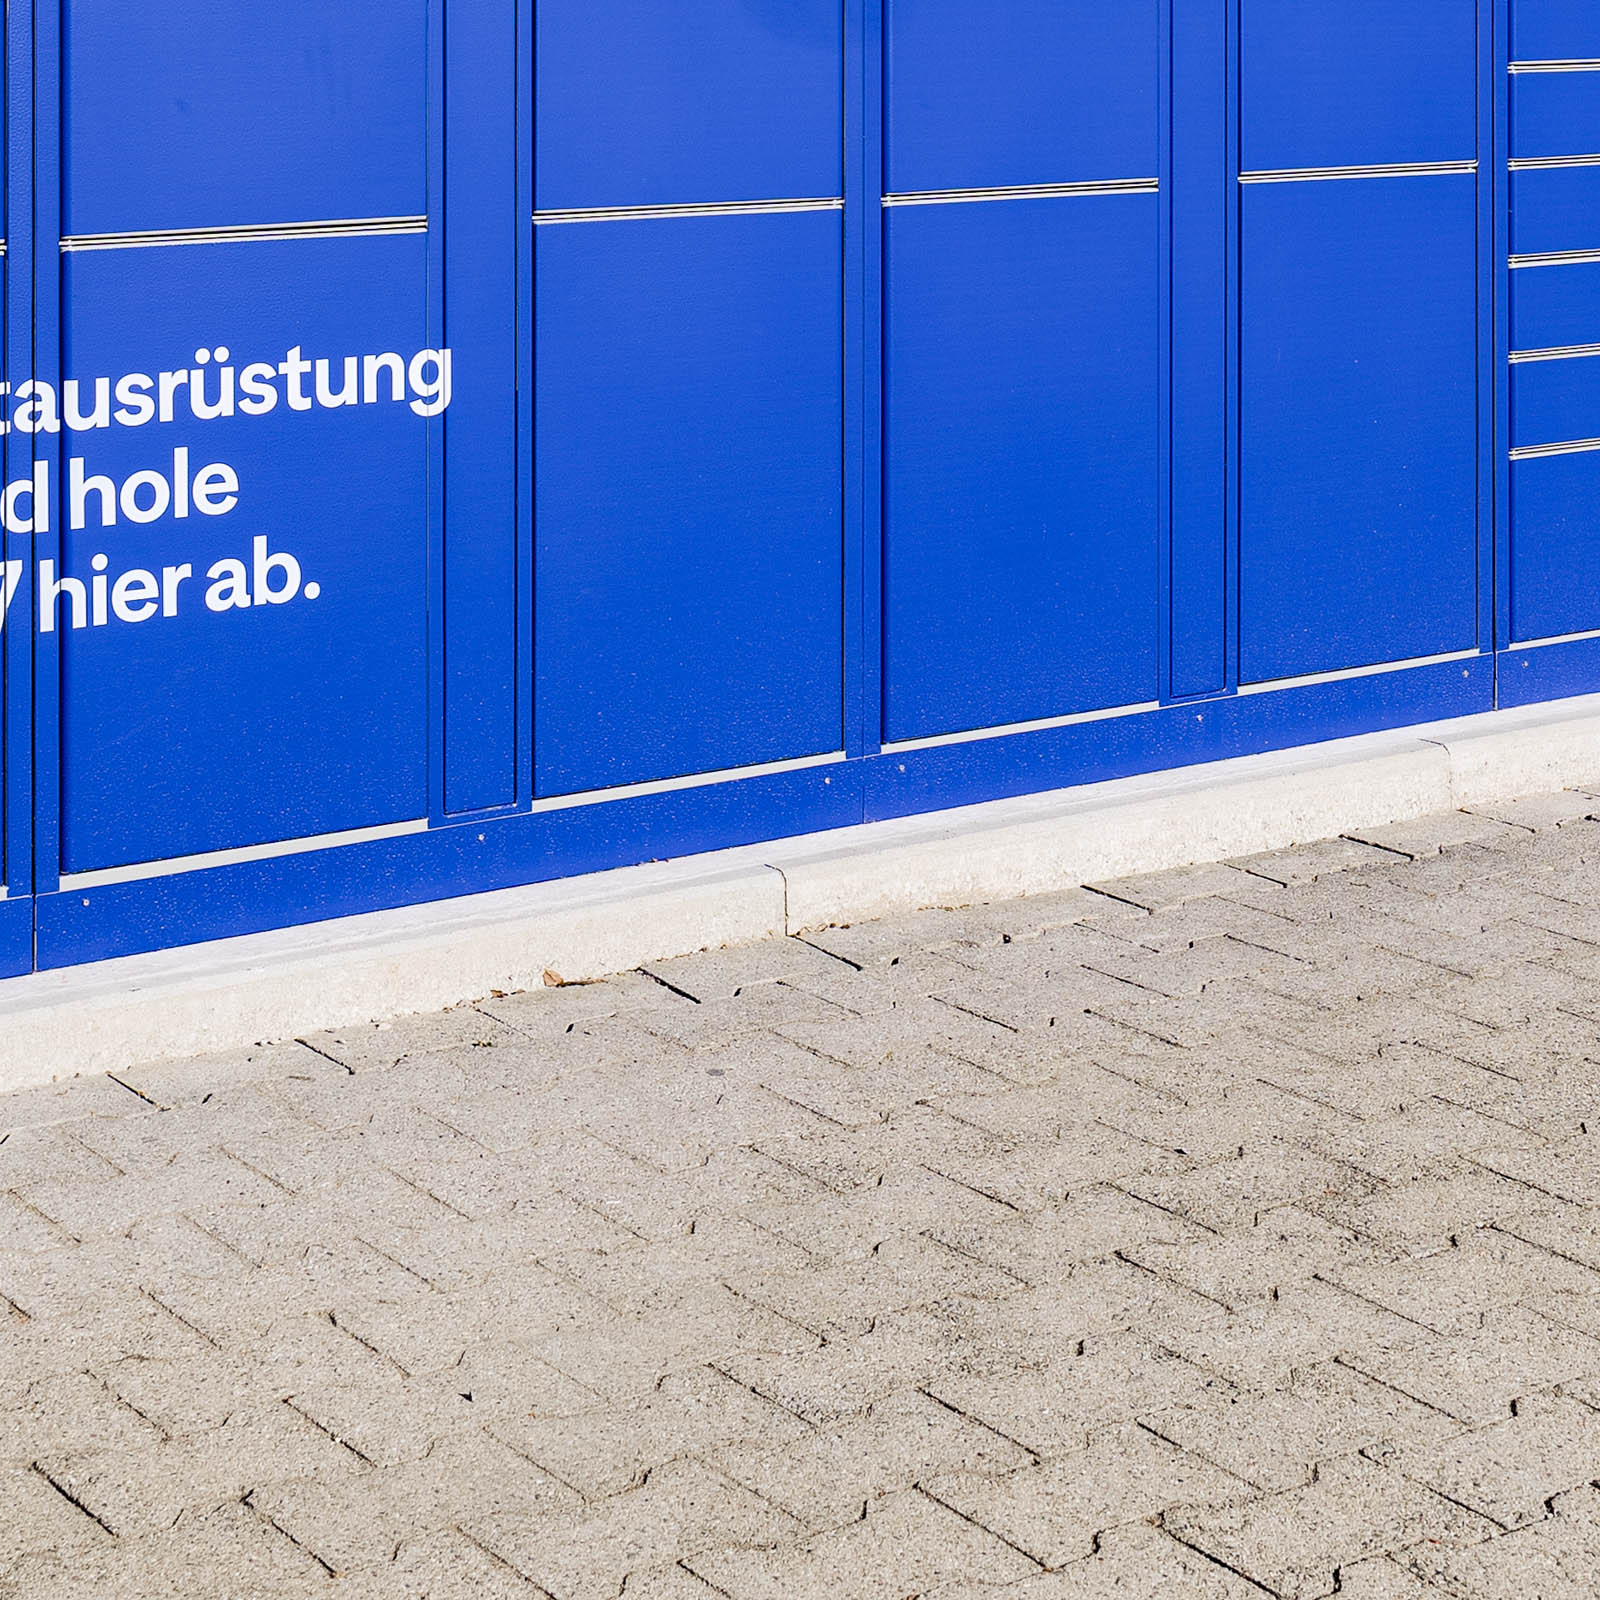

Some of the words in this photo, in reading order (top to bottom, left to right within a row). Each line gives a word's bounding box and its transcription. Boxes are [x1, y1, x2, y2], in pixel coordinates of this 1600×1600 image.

[69, 446, 240, 530] hole
[39, 553, 192, 633] hier
[205, 535, 321, 612] ab.
